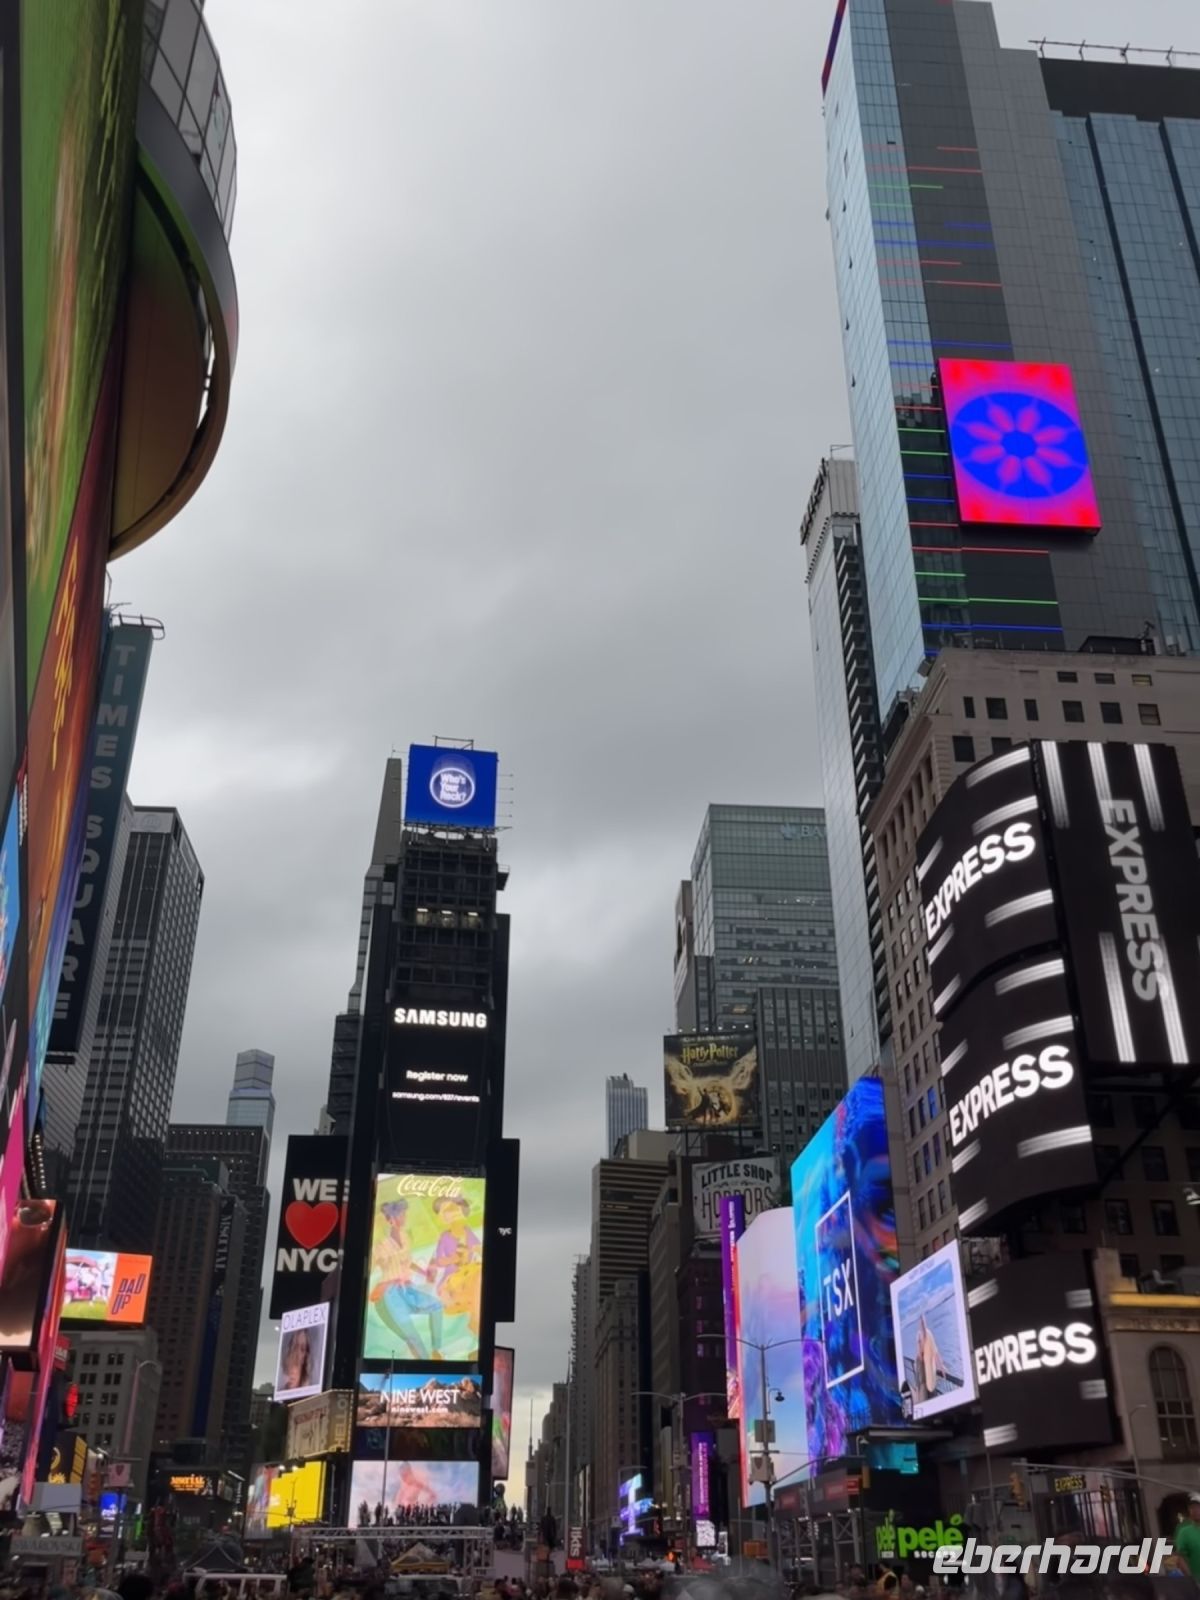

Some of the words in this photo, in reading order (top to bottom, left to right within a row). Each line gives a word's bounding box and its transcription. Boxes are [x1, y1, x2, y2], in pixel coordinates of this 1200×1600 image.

[90, 644, 136, 790] TIMES
[926, 822, 1036, 941] EXPRESS
[1102, 799, 1165, 1002] EXPRESS
[394, 1007, 487, 1028] SAMSUNG
[682, 1046, 709, 1064] Harry
[709, 1043, 738, 1060] Potter
[406, 1070, 445, 1082] Register
[446, 1074, 468, 1082] now
[949, 1045, 1074, 1147] EXPRESS
[701, 1163, 740, 1188] LITTLE
[743, 1163, 773, 1183] SHOP
[292, 1178, 338, 1201] WE
[276, 1248, 339, 1273] NYC
[823, 1257, 854, 1322] TSX
[974, 1322, 1097, 1385] EXPRESS
[380, 1388, 416, 1404] NINE
[420, 1388, 460, 1404] WEST
